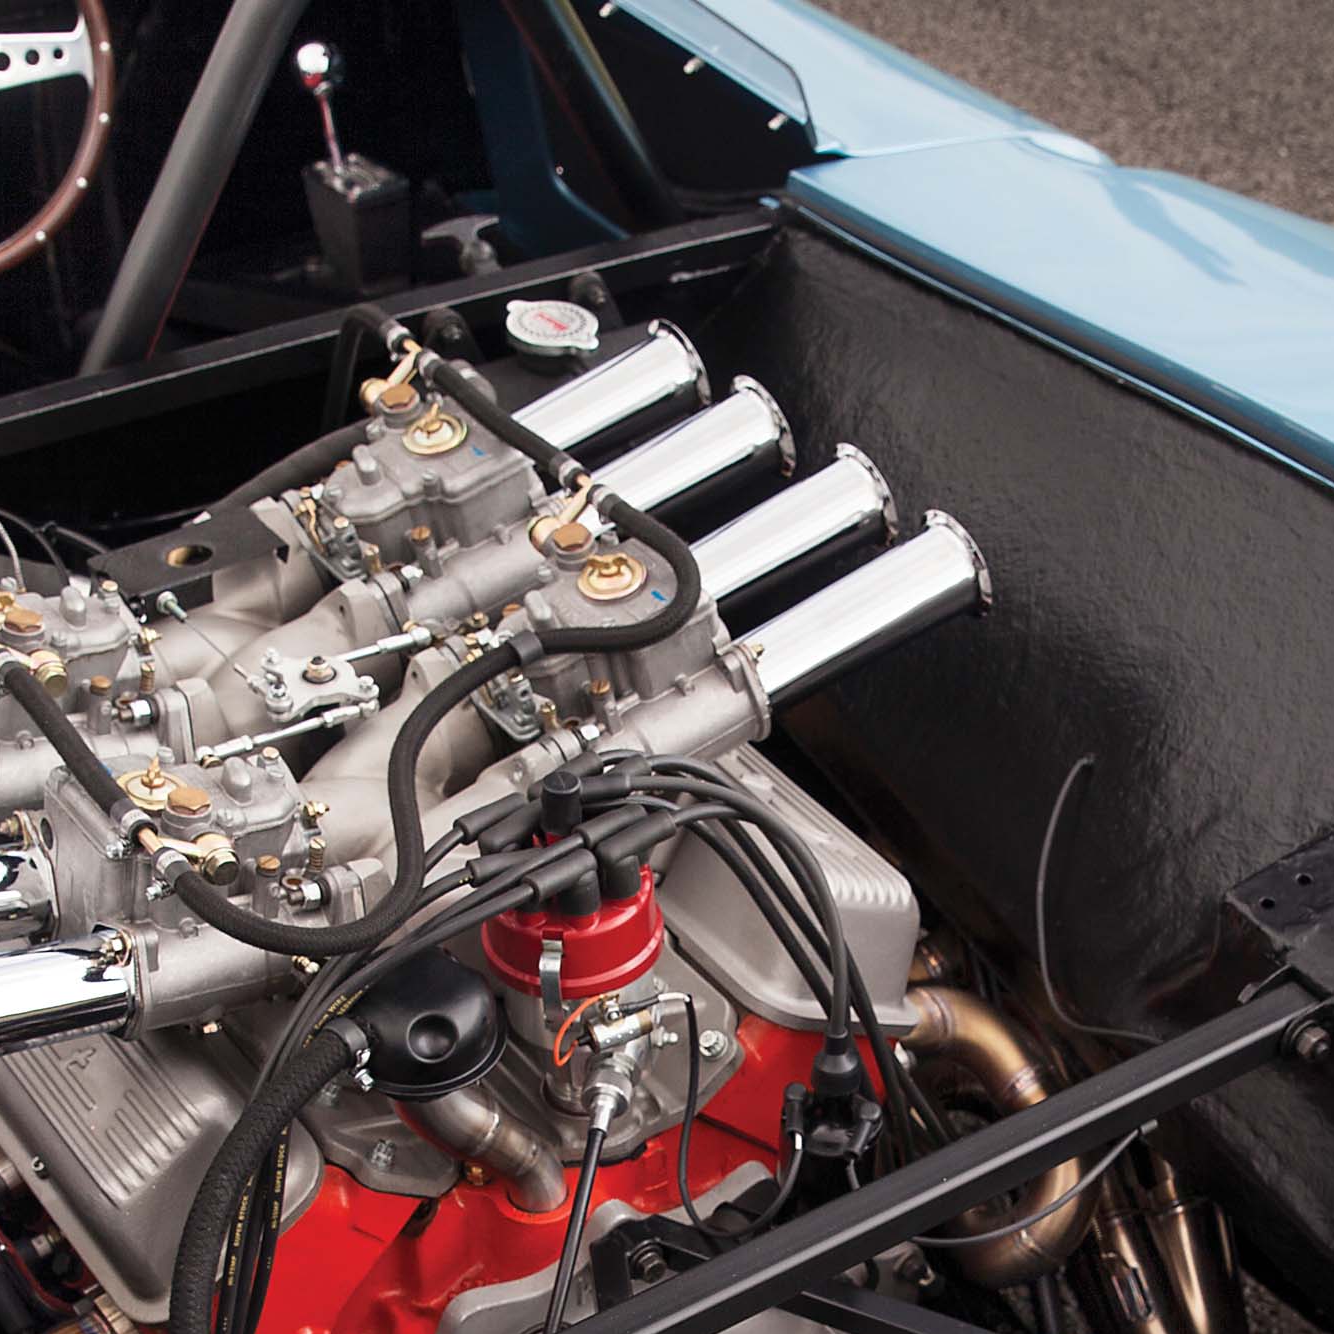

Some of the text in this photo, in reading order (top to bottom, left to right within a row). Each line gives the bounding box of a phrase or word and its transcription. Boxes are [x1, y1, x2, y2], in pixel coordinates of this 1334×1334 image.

[277, 1143, 286, 1169] STOCK
[274, 1169, 283, 1194] SUPER
[238, 1194, 249, 1221] STOCK
[233, 1221, 244, 1247] SUPER
